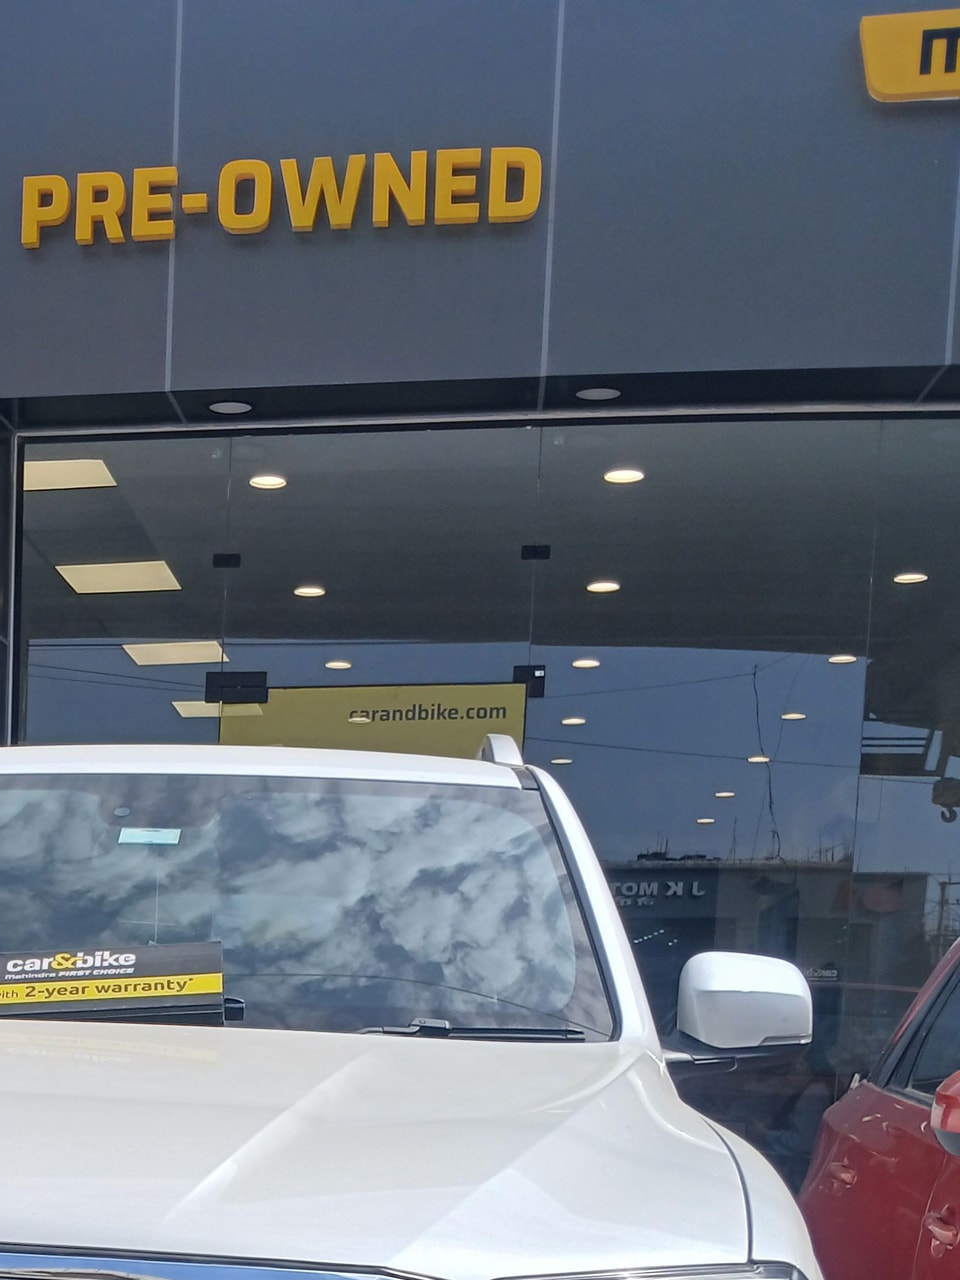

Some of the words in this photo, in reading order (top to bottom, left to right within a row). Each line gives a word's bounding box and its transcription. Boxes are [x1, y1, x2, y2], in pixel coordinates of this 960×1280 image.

[20, 146, 543, 250] PRE-OWNED
[348, 702, 507, 722] carandbike.com
[6, 951, 137, 972] car&bike
[57, 969, 92, 977] FIRST
[92, 967, 135, 976] CHOICE
[24, 984, 90, 999] 2-year
